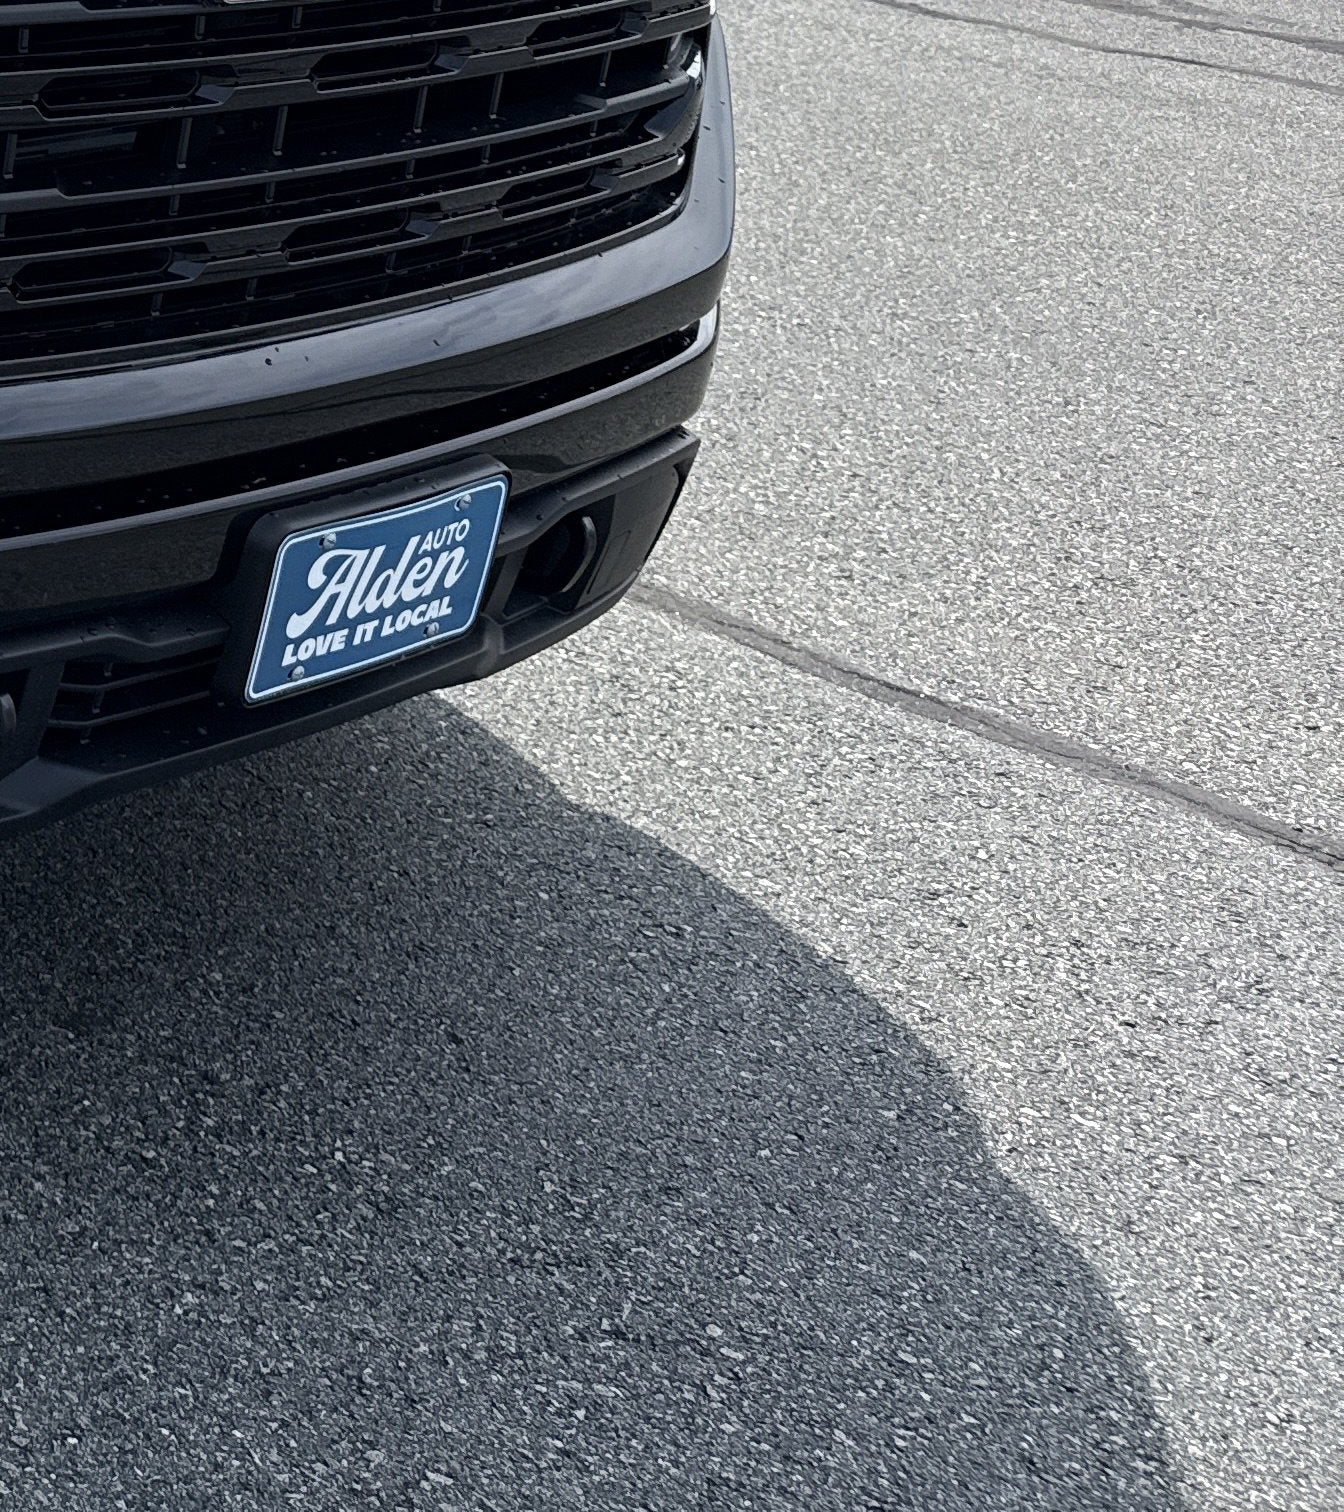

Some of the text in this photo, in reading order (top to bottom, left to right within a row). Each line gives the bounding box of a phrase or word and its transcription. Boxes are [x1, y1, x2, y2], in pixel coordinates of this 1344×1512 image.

[418, 518, 470, 555] AUTO
[286, 534, 470, 639] Alden
[281, 596, 452, 667] LOVE IT LOCAL
